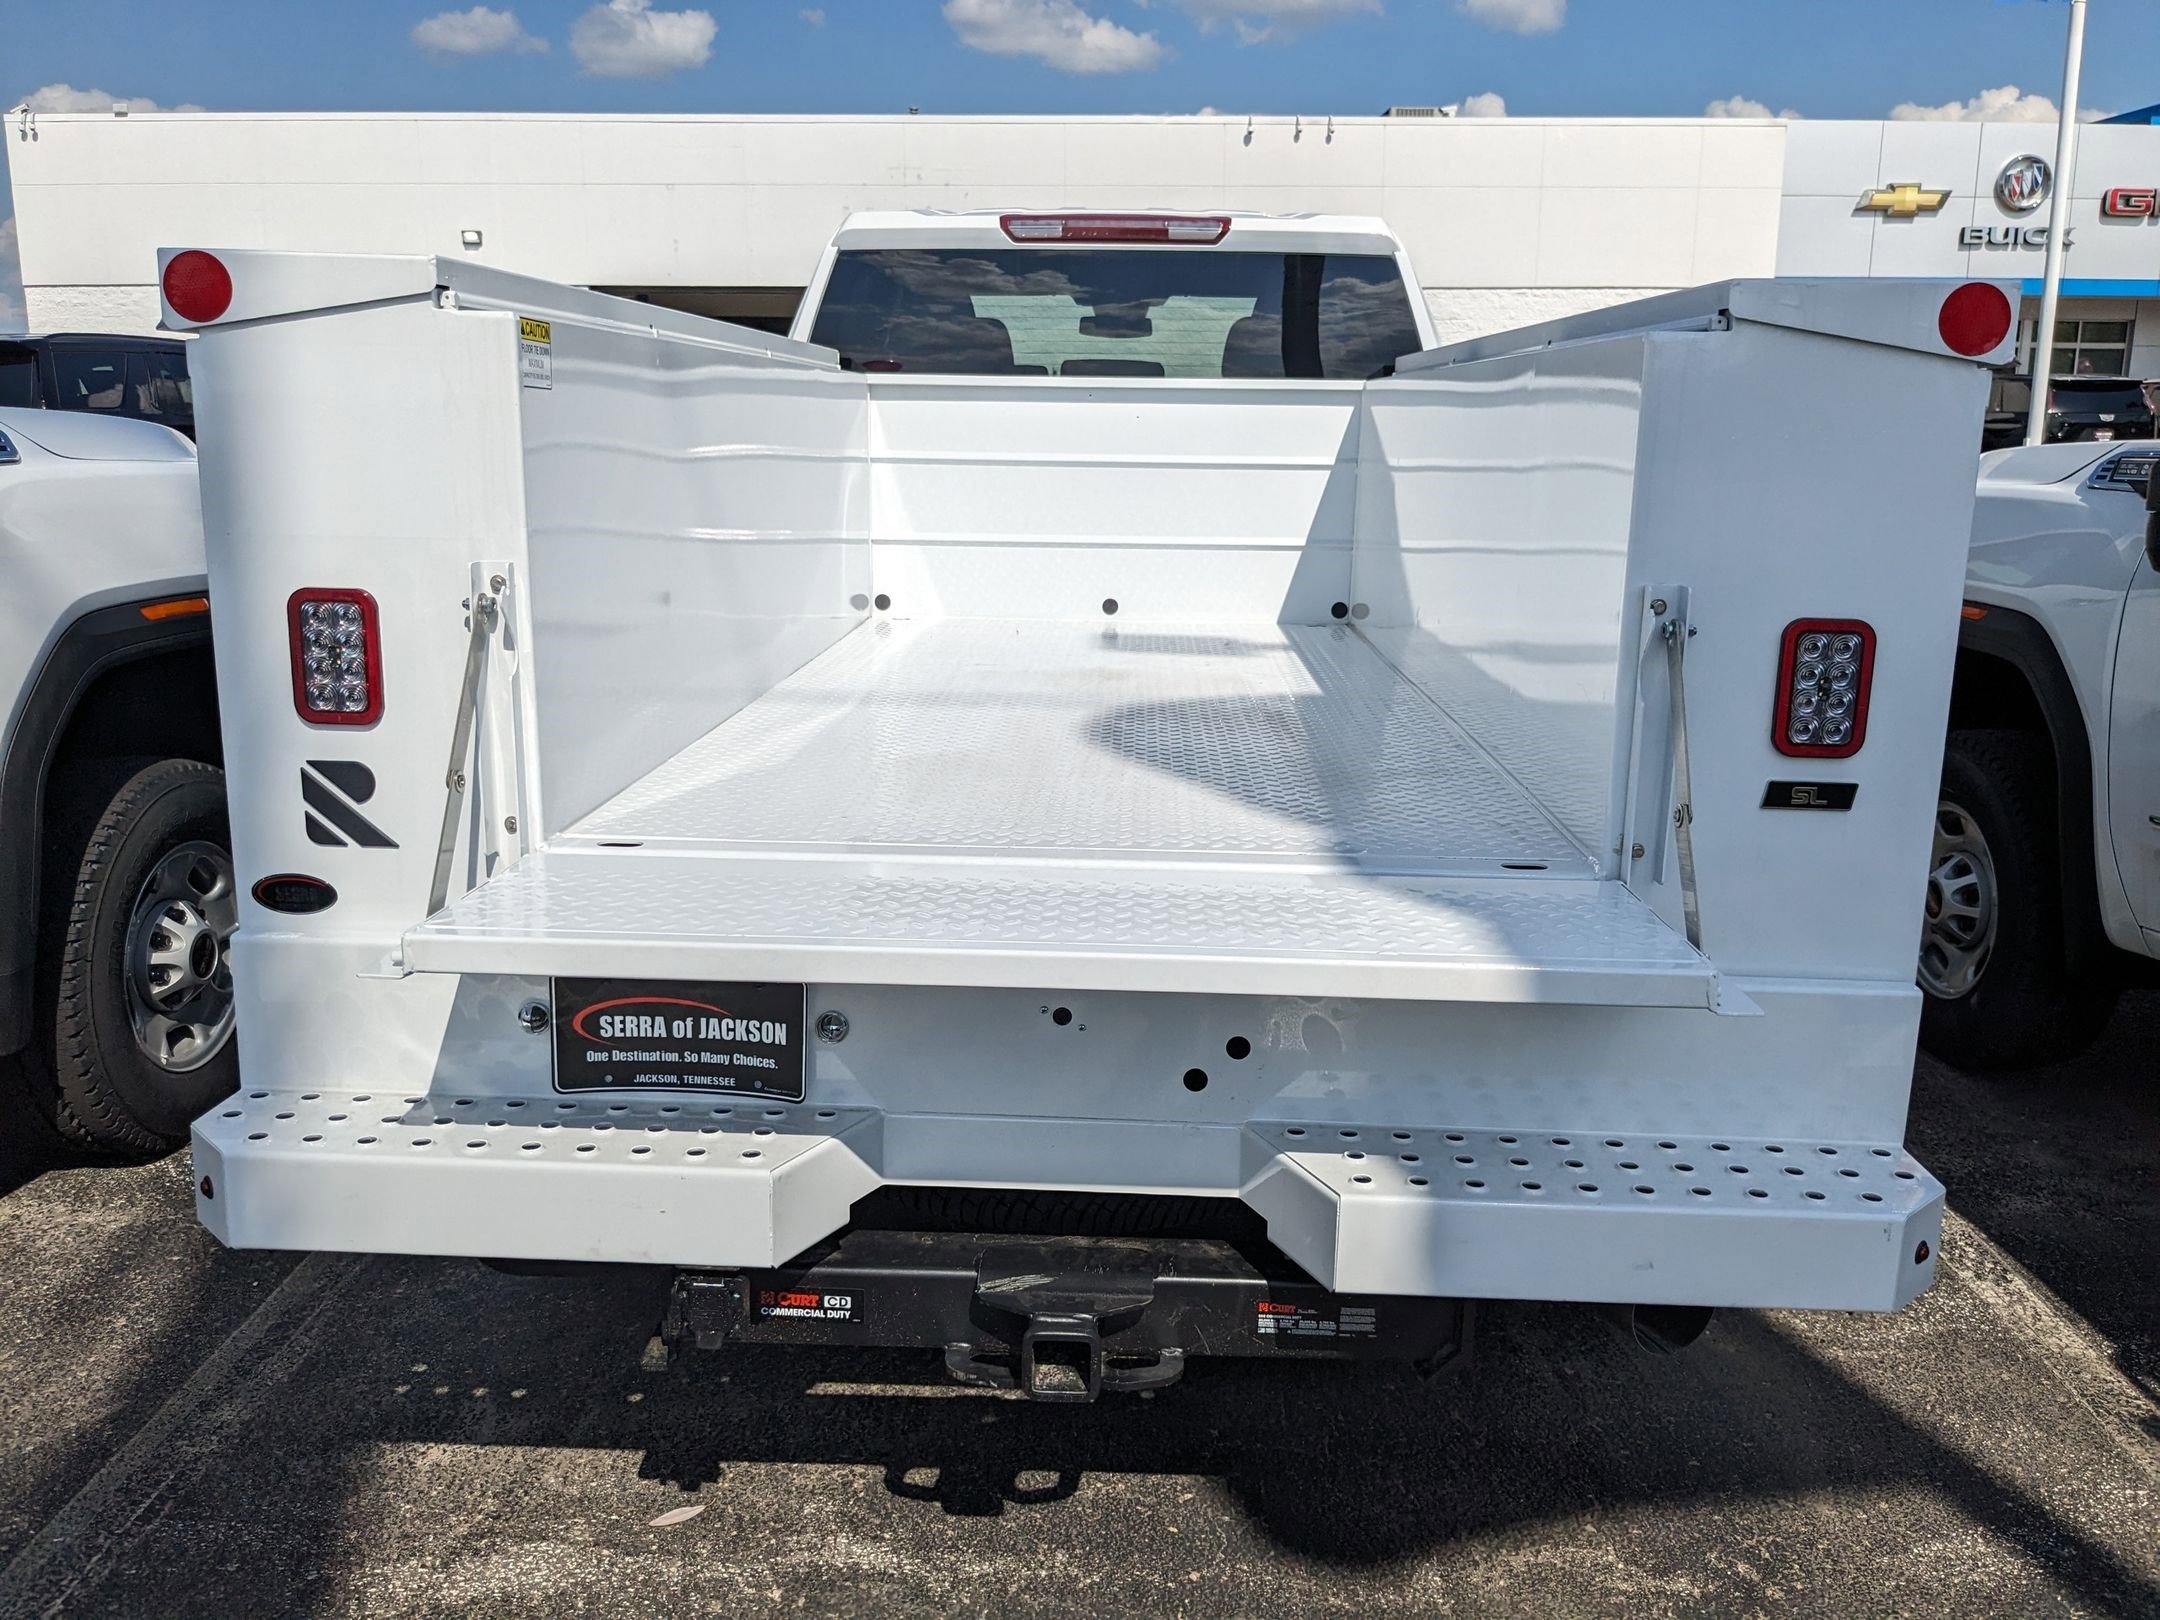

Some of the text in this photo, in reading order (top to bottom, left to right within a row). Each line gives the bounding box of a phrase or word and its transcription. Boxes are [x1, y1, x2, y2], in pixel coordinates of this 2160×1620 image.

[525, 321, 550, 340] CAUTION
[1791, 786, 1828, 805] SL
[599, 1015, 787, 1046] SERRA of JACKSON
[586, 1050, 779, 1069] One Destination. So Many Choices.
[633, 1074, 736, 1087] JACKSON, TENNESSEE
[778, 1292, 848, 1307] CURT CD
[761, 1307, 851, 1320] COMMERCIAL DUTY
